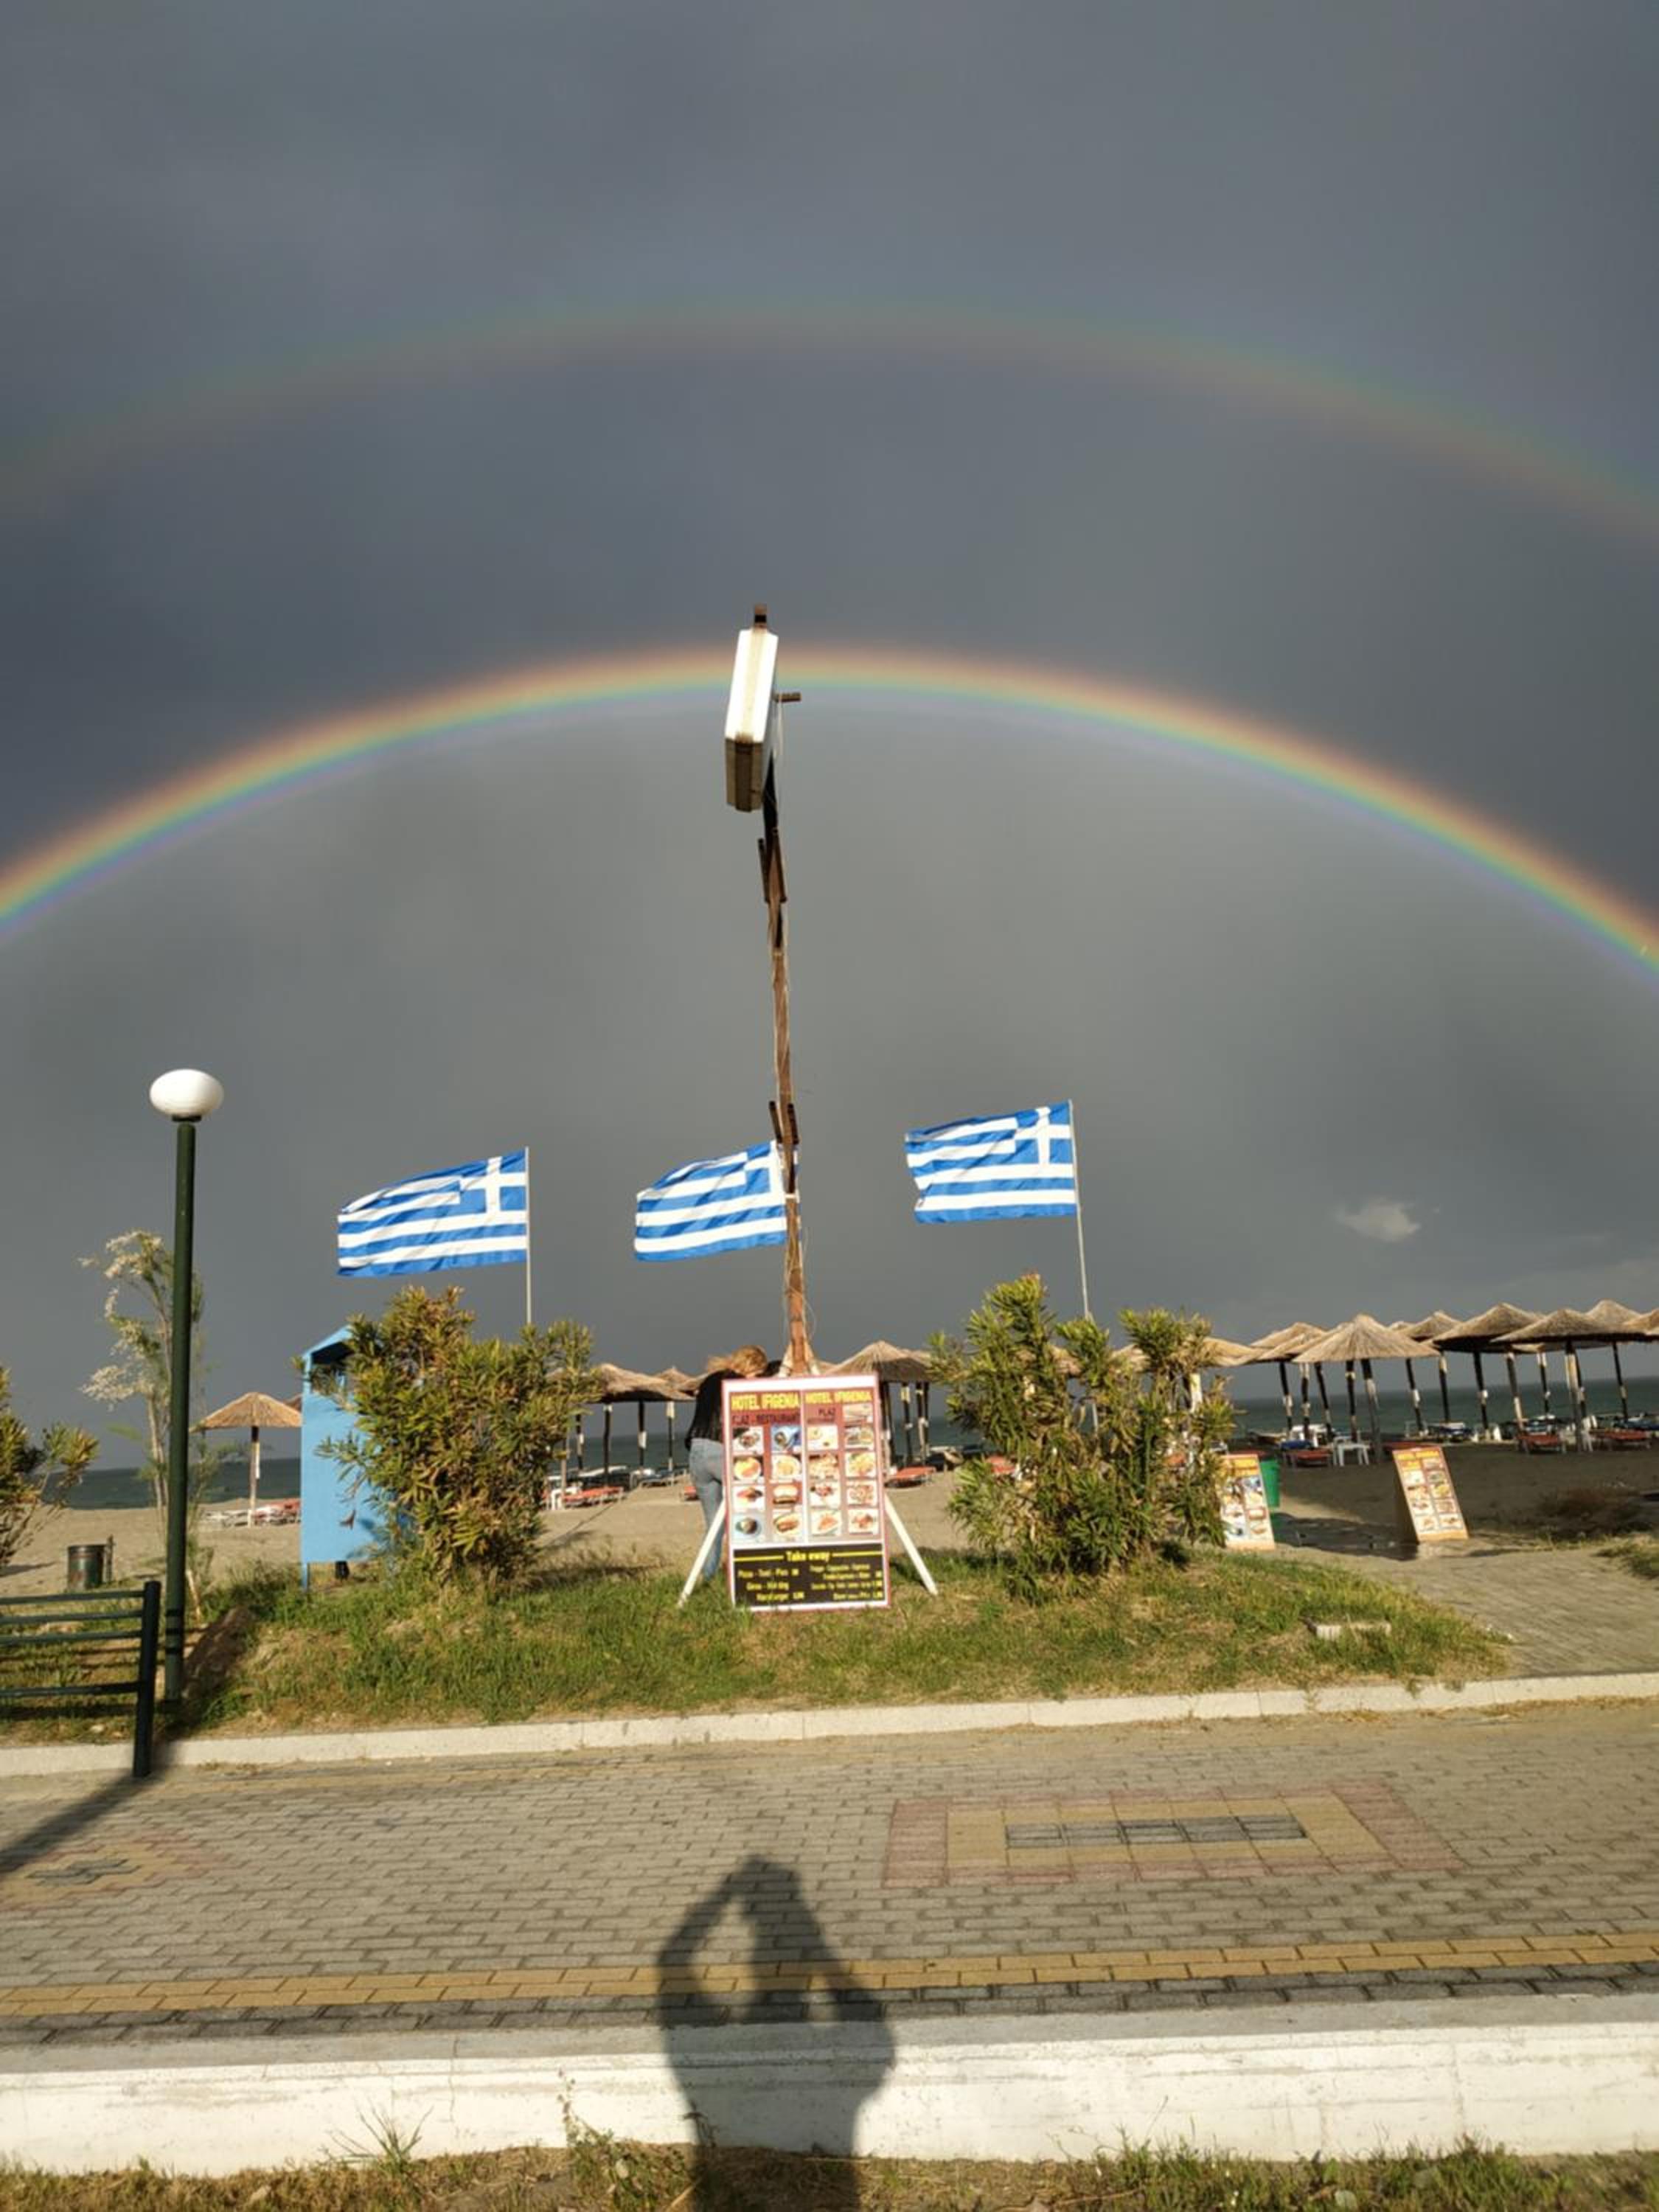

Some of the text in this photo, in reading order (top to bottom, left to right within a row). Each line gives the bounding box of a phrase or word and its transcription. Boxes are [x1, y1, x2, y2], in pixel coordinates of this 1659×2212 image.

[731, 1394, 759, 1411] HOTEL
[805, 1391, 832, 1404] HOTEL
[785, 1551, 831, 1562] Take away
